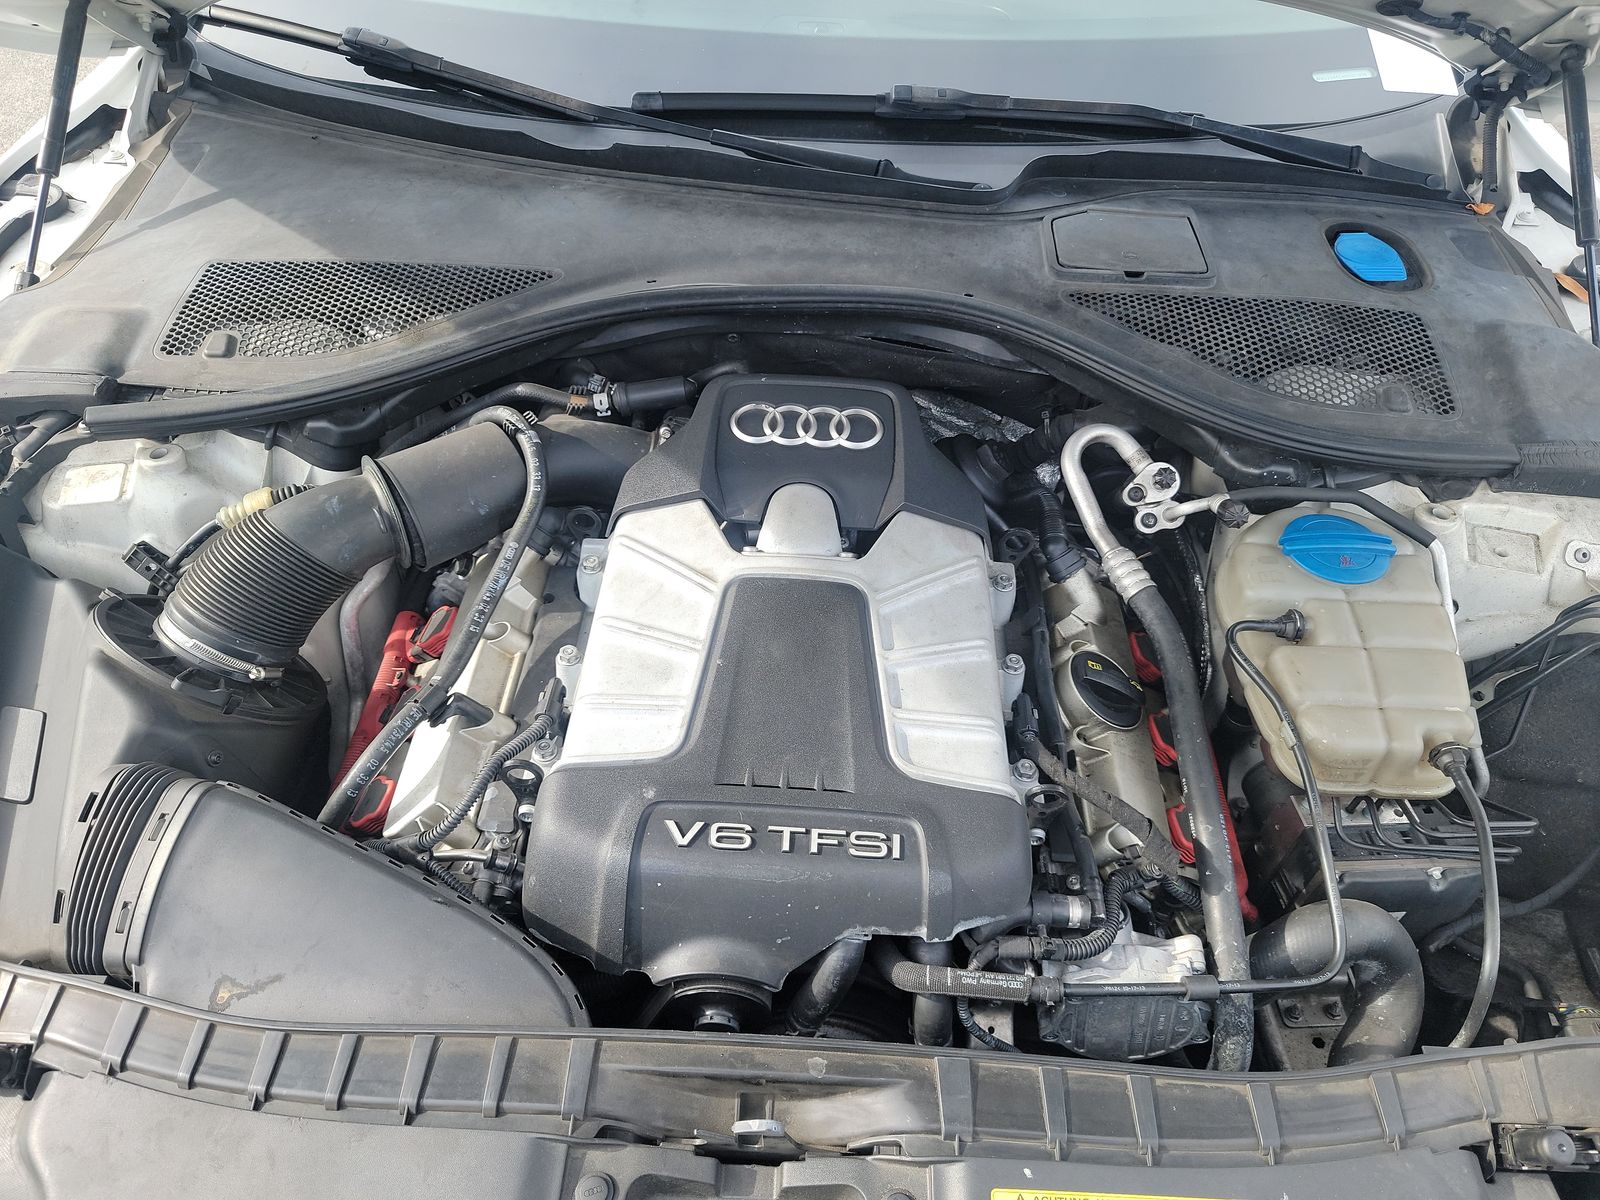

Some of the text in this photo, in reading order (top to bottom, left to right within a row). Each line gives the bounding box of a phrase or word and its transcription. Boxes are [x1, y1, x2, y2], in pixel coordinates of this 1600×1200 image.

[366, 758, 379, 770] 02
[356, 773, 369, 785] 33
[346, 788, 358, 798] 13
[664, 820, 903, 860] V6 TFSI
[980, 977, 1007, 988] Germany
